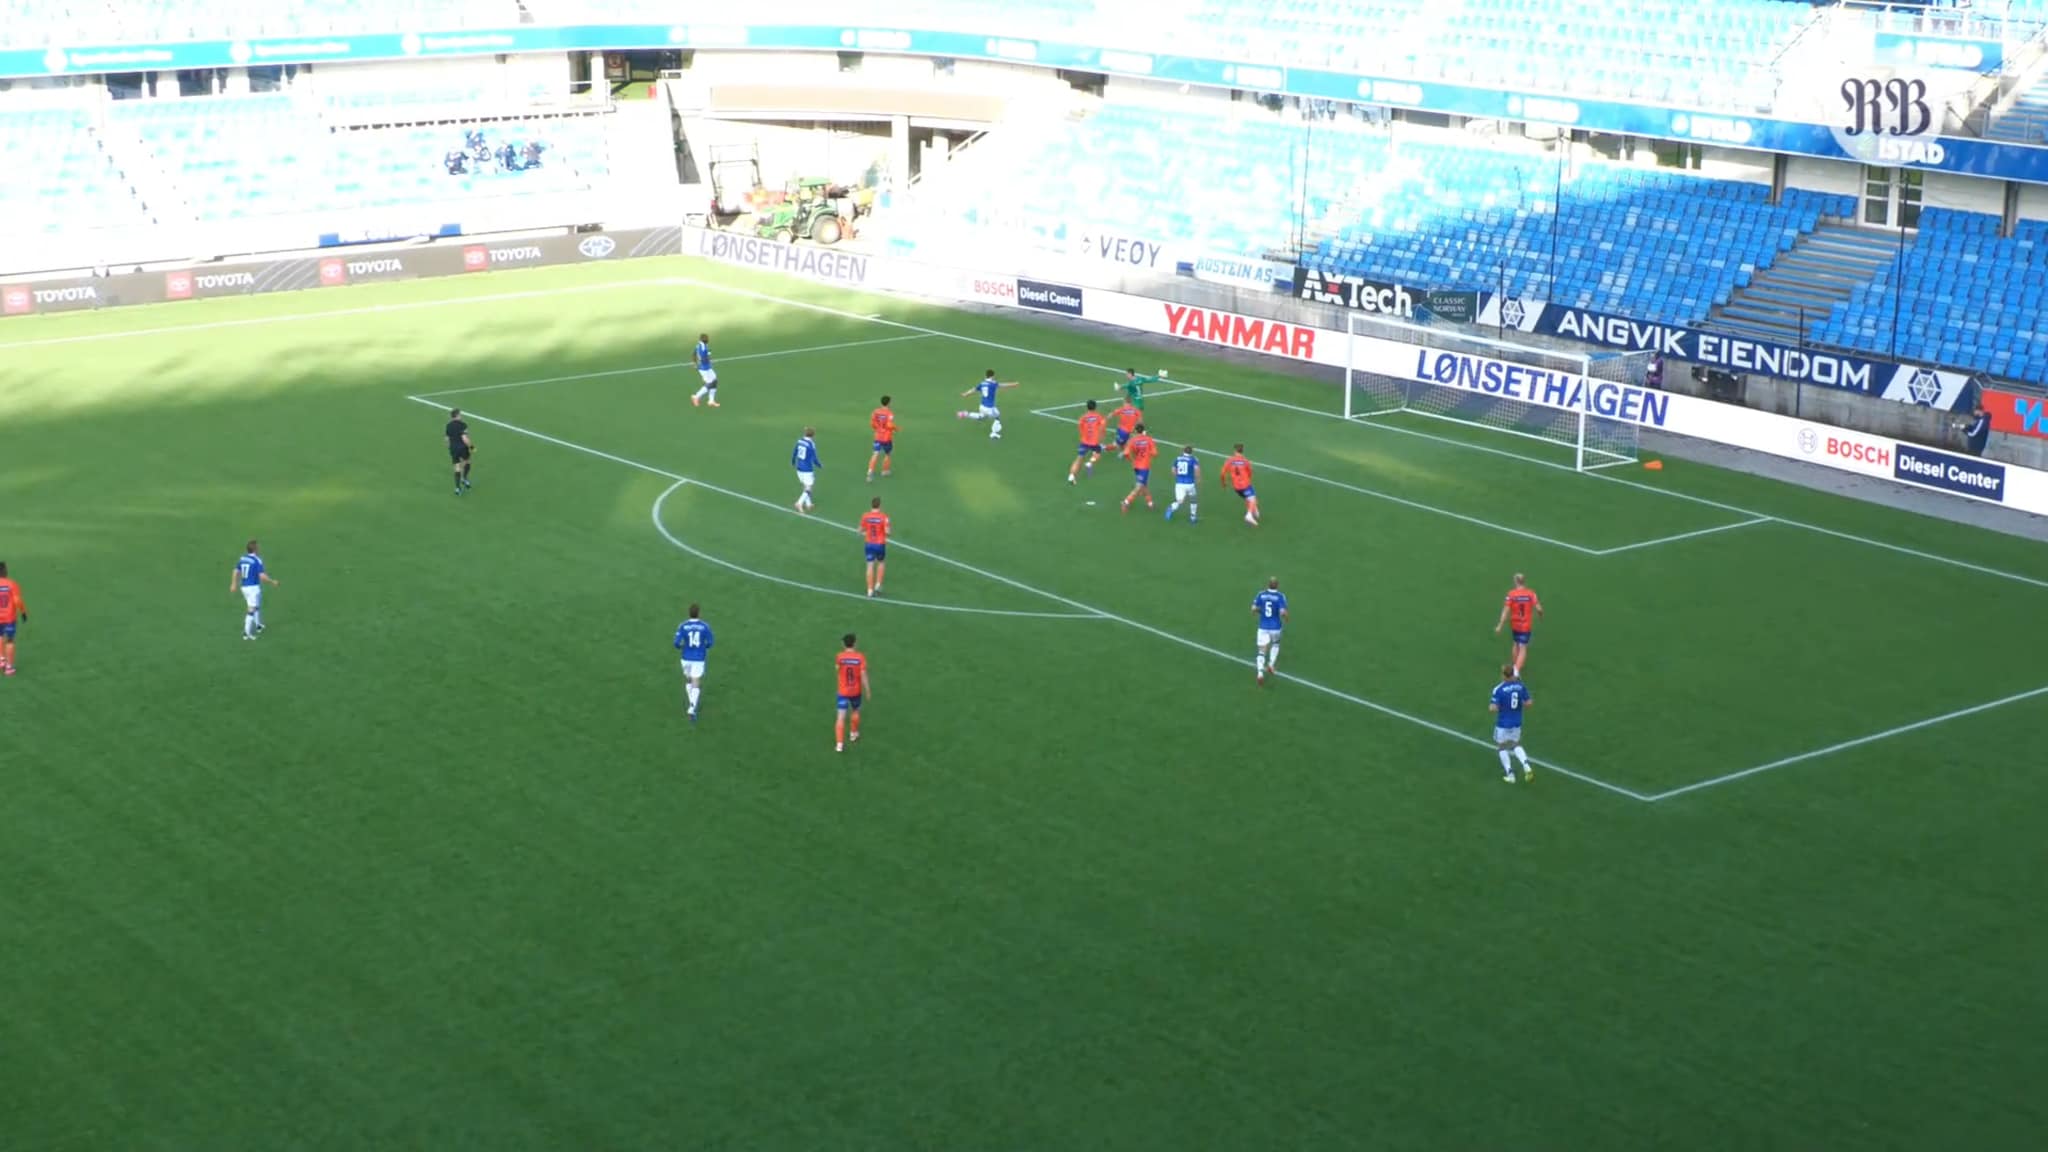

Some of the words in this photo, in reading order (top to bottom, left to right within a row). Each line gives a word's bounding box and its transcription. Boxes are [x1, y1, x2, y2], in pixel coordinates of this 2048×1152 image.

[489, 247, 541, 261] TOYOTA
[700, 230, 867, 282] LØNSETHAGEN
[347, 258, 402, 274] TOYOTA
[1254, 266, 1272, 283] AS
[196, 273, 254, 288] TOYOTA
[34, 286, 96, 303] TOYOTA
[974, 279, 1014, 298] BOSCH
[1020, 287, 1048, 302] Diesel
[1049, 291, 1081, 307] Center
[1164, 303, 1315, 359] YANMAR
[1558, 311, 1686, 357] ANGVIK
[1699, 335, 1870, 391] EIENDOM
[1416, 349, 1669, 426] LØNSETHAGEN
[1827, 437, 1890, 466] BOSCH
[1899, 454, 1944, 478] Diesel
[1948, 466, 2000, 490] Center
[1265, 600, 1273, 618] 5
[688, 631, 700, 648] 14
[1511, 691, 1519, 709] 6
